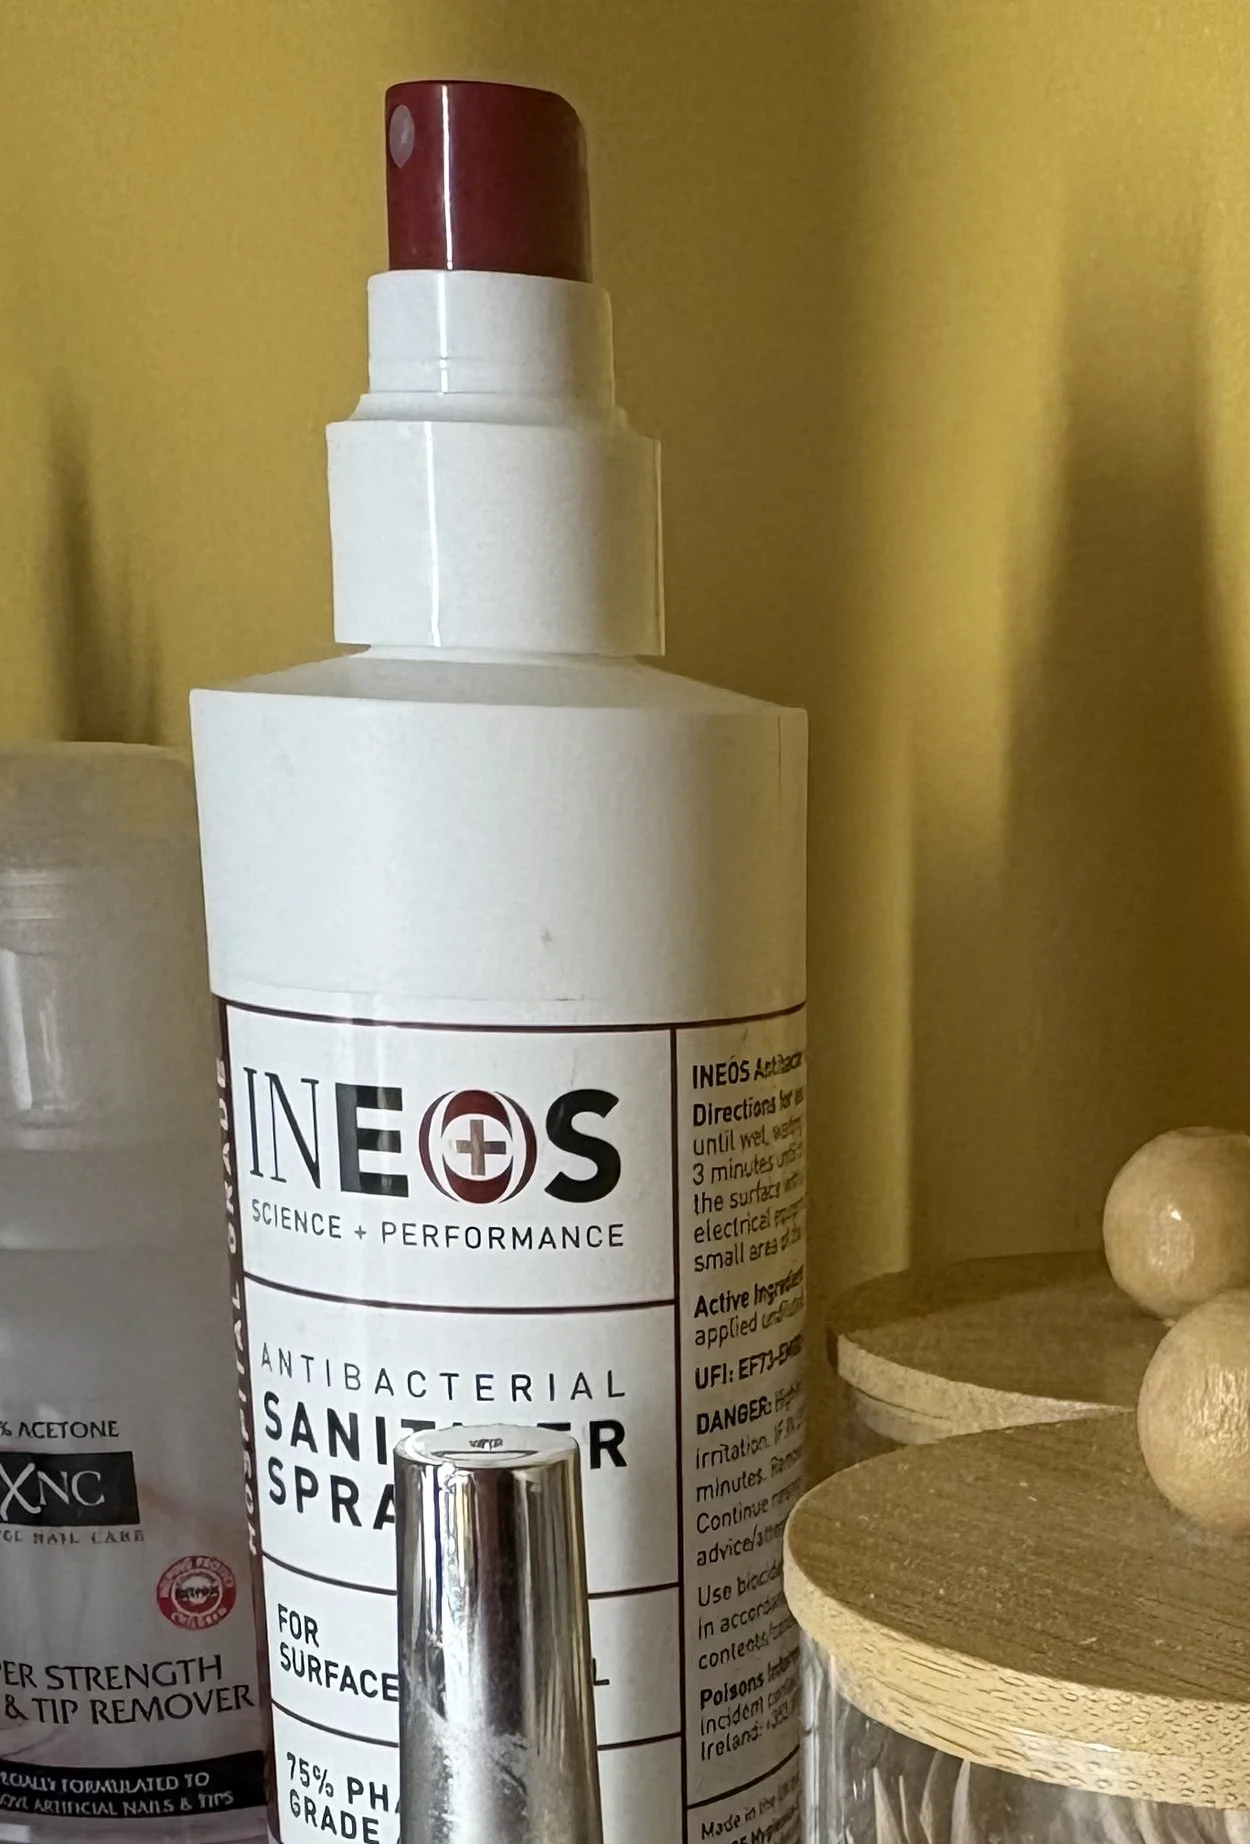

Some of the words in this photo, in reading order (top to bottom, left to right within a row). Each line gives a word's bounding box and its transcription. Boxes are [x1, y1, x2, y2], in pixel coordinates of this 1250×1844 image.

[692, 1059, 750, 1089] INEOS
[693, 1096, 776, 1127] Directions
[243, 1067, 621, 1204] INEOS
[693, 1129, 734, 1156] until
[693, 1163, 704, 1185] 3
[711, 1155, 773, 1184] minutes
[694, 1193, 724, 1215] the
[252, 1199, 342, 1241] SCIENCE
[381, 1222, 625, 1250] PERFORMANCE
[694, 1206, 770, 1243] electrical
[694, 1242, 744, 1273] small
[694, 1290, 749, 1319] Active
[695, 1312, 758, 1349] applied
[260, 1342, 626, 1402] ANTIBACTERIAL
[695, 1362, 734, 1390] UFI:
[18, 1420, 119, 1439] ACETONE
[264, 1391, 628, 1470] SANIR
[268, 1456, 397, 1530] SPRA
[697, 1497, 769, 1534] Continue
[698, 1584, 732, 1607] Use
[278, 1603, 319, 1648] FOR
[0, 1660, 37, 1689] ER
[45, 1654, 222, 1691] STRENGTH
[4, 1694, 29, 1720] &
[31, 1697, 78, 1724] TIP
[90, 1684, 256, 1724] REMOVER
[700, 1672, 765, 1710] Poisons
[61, 1776, 179, 1794] FORMULATED
[184, 1772, 210, 1788] TO
[286, 1751, 334, 1798] 75%
[34, 1798, 119, 1816] ARTIFICIAL
[123, 1799, 175, 1816] NAILS
[198, 1790, 234, 1809] TIPS
[701, 1814, 740, 1840] Made
